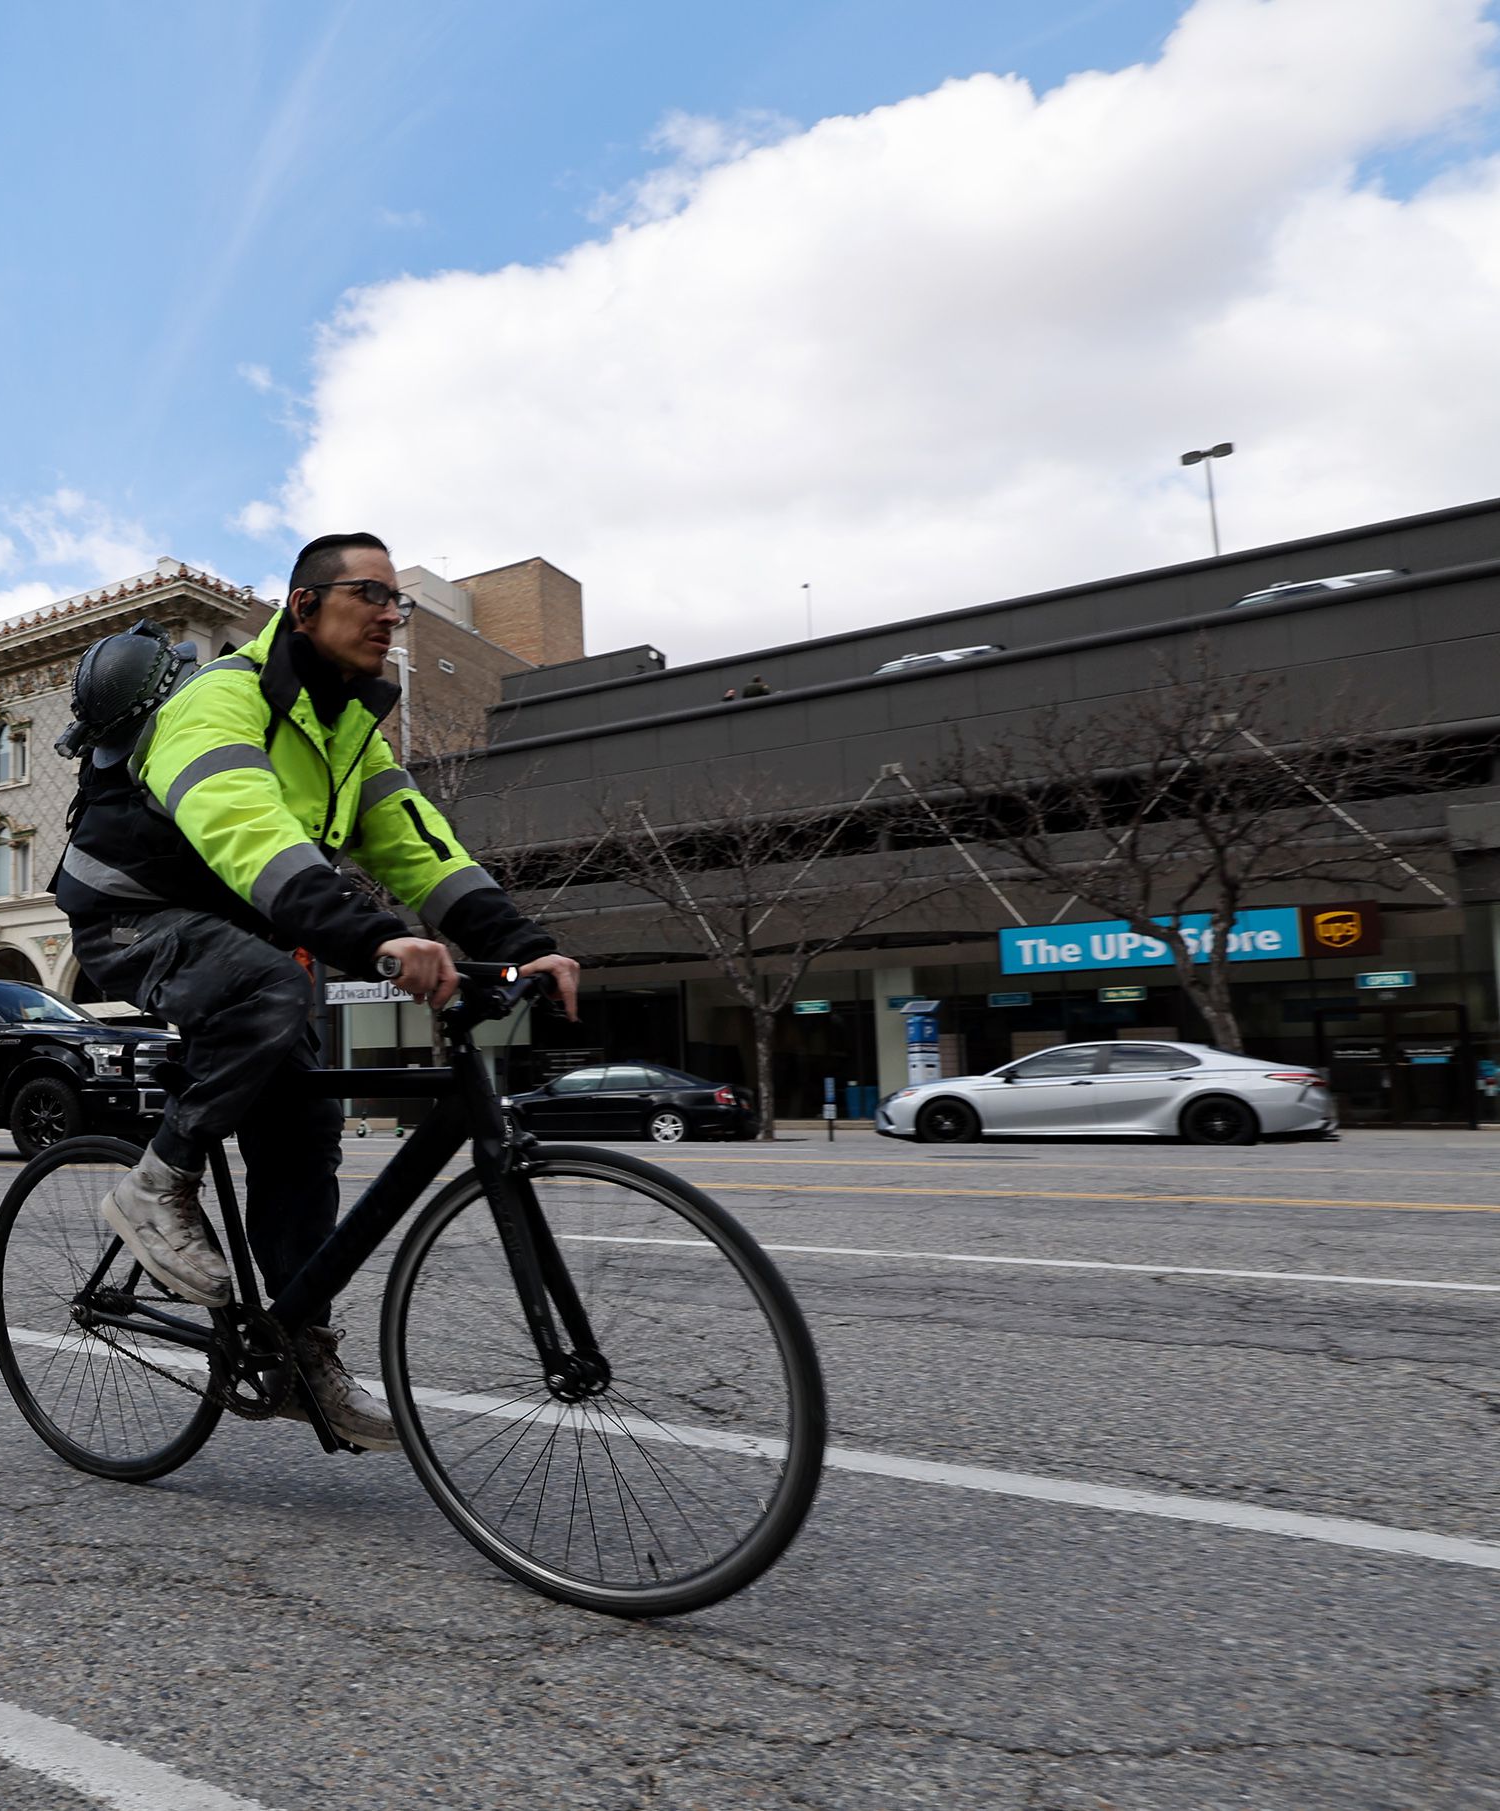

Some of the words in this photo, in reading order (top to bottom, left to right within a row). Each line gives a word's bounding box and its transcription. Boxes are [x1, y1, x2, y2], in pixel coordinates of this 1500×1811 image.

[1015, 938, 1083, 966] The
[1090, 932, 1168, 961] UPS
[326, 982, 381, 1000] Edward
